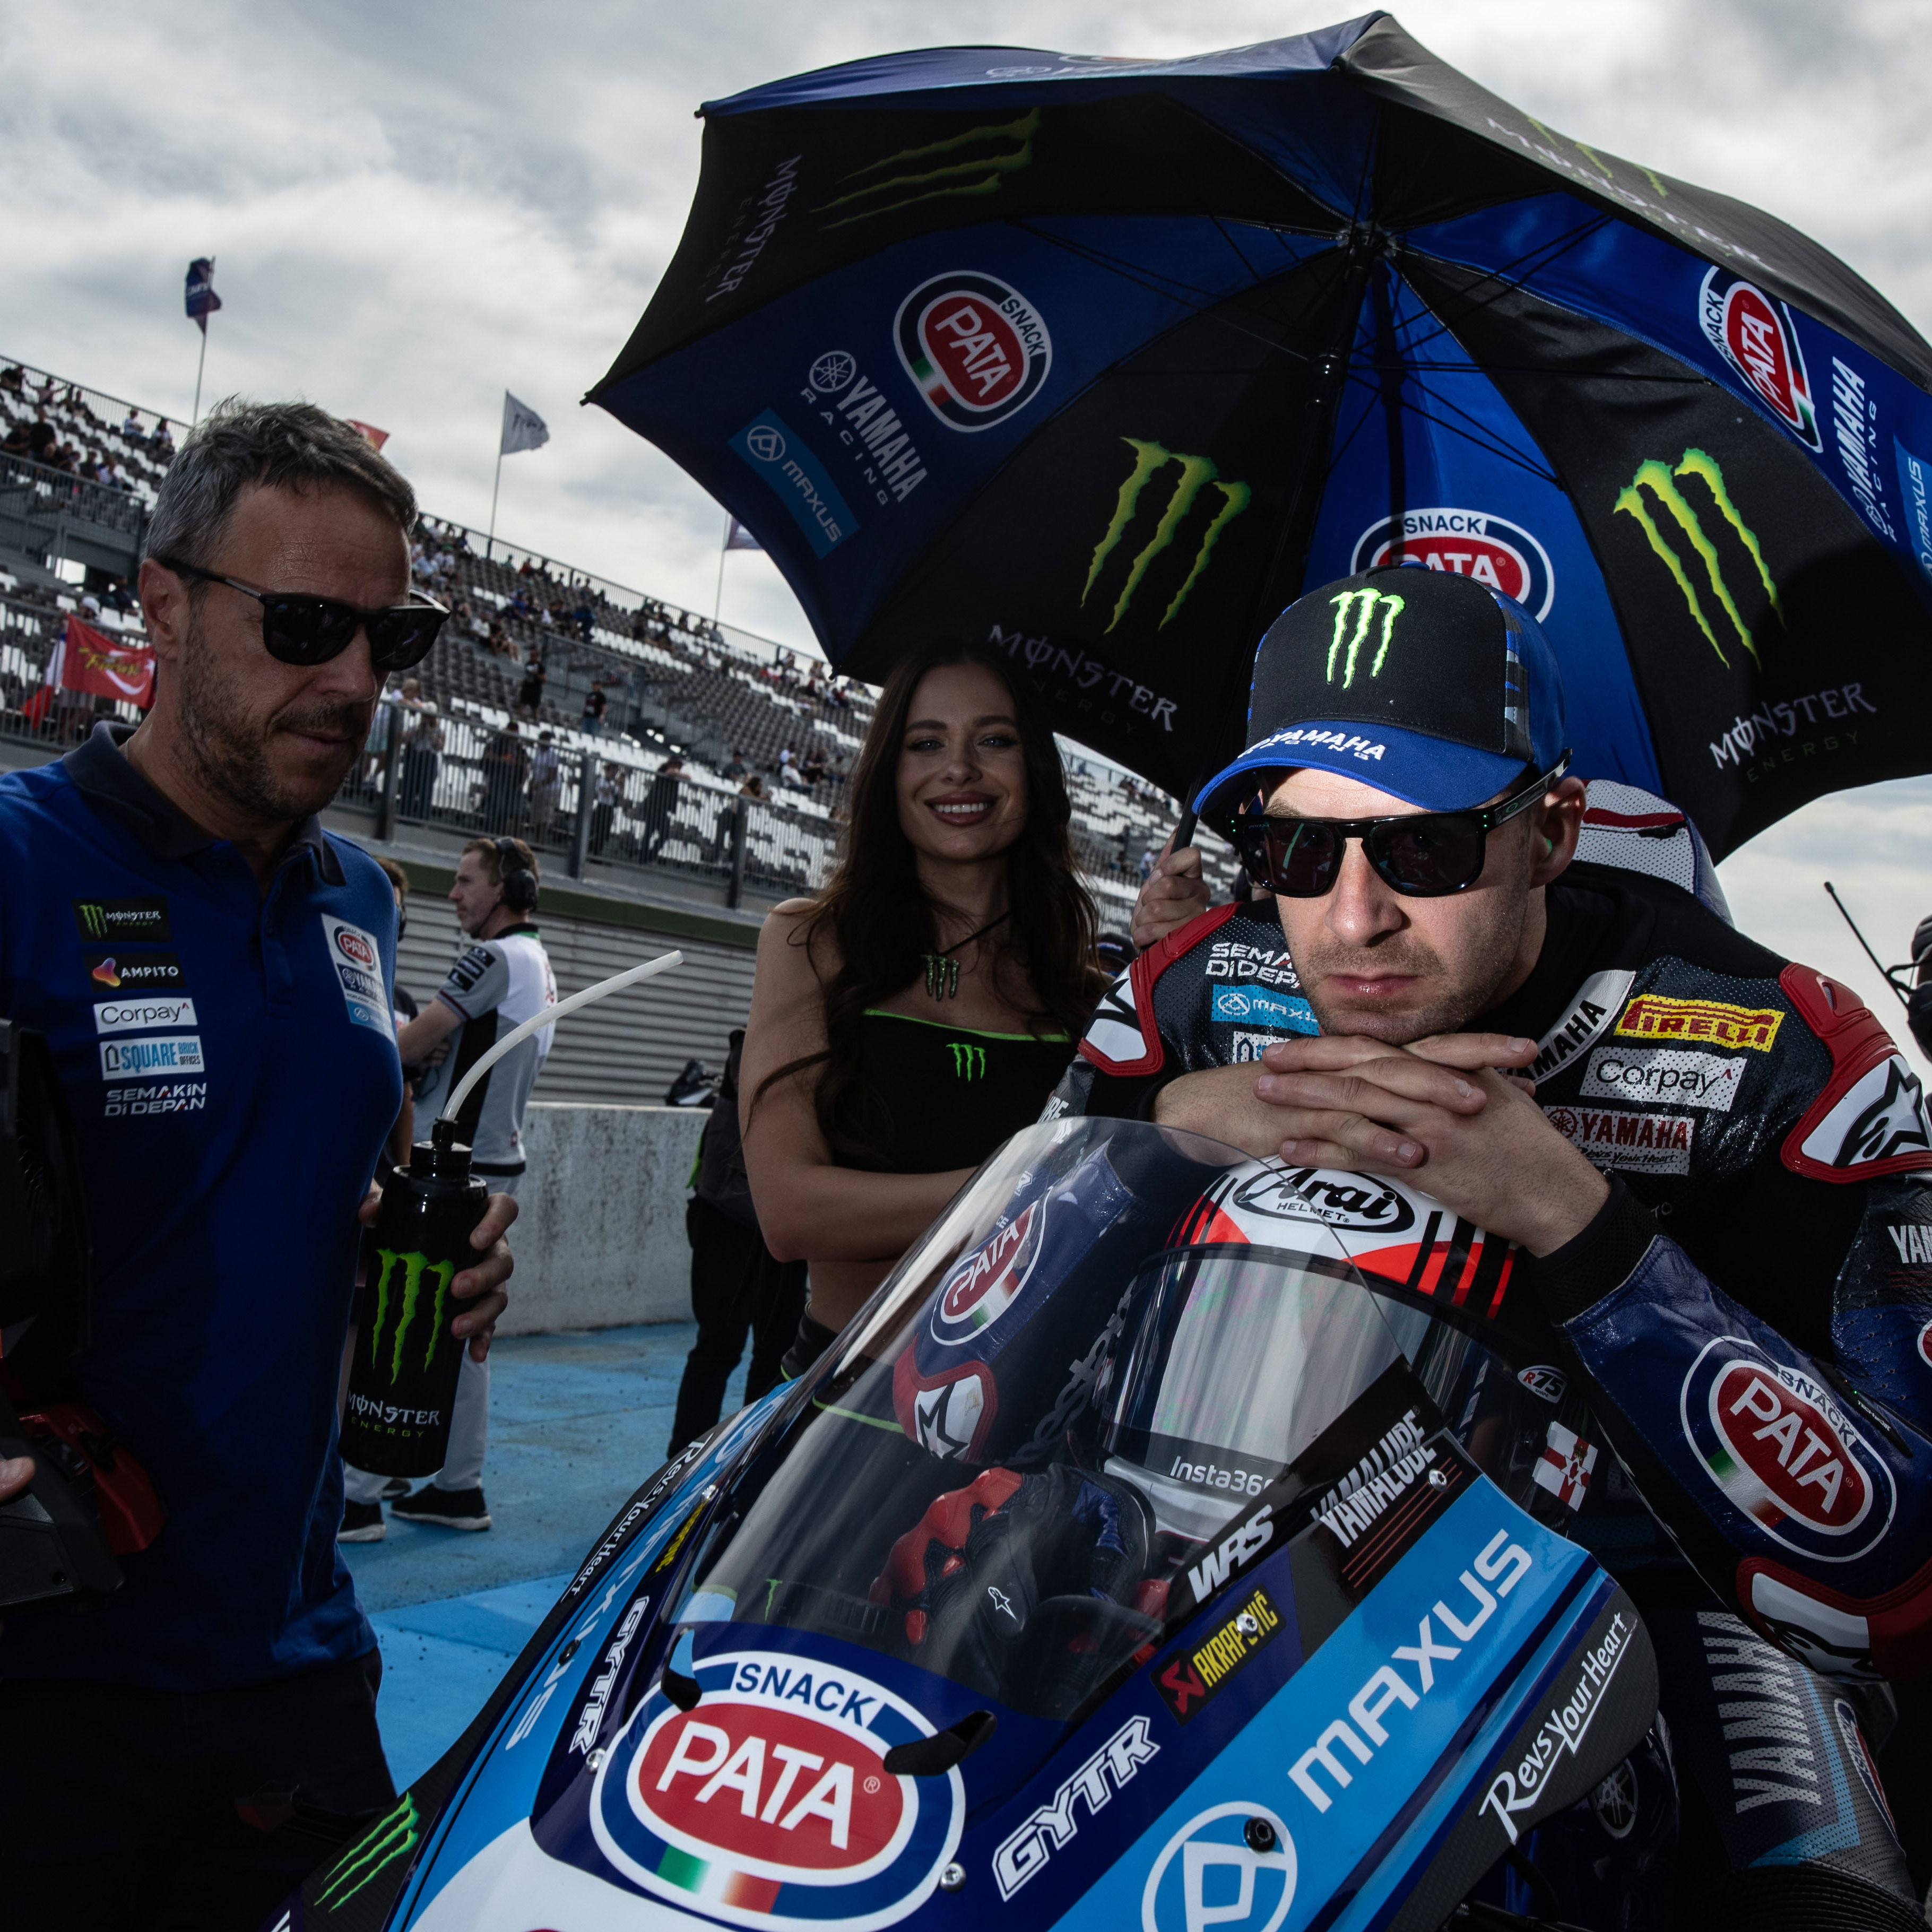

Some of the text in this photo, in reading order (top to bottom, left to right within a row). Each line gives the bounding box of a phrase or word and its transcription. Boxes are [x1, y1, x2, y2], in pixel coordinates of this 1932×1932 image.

[705, 153, 802, 302] MONSTER
[935, 305, 1012, 397] PATA
[1001, 298, 1046, 355] SNACK
[1706, 295, 1737, 363] SNACK
[1741, 311, 1781, 404] PATA
[800, 388, 889, 505] RACING
[836, 375, 929, 503] YAMAHA
[1832, 356, 1876, 501] YAMAHA
[781, 459, 843, 543] MAXUS
[1867, 401, 1898, 543] RACING
[1404, 515, 1483, 534] SNACK
[1908, 456, 1932, 555] MAXUS
[986, 624, 1179, 732] MONSTER
[1271, 729, 1387, 760] YAMAHA
[1708, 681, 1878, 770] MONSTER
[1746, 730, 1858, 783] ENERGY
[106, 910, 161, 922] MONSTER
[343, 937, 369, 958] PATA
[121, 965, 179, 979] AMPITO
[1209, 942, 1294, 969] SEMA
[101, 1006, 181, 1025] Corpay
[178, 1042, 200, 1054] BRICK
[1621, 999, 1773, 1045] PIRELLI
[120, 1042, 178, 1073] SQUARE
[179, 1055, 201, 1065] OFFICES
[1596, 1059, 1719, 1099] Corpay
[107, 1082, 207, 1103] SEMAKIN
[130, 1096, 206, 1115] DEPAN
[1581, 1112, 1688, 1151] YAMAHA
[1238, 1167, 1397, 1219] Arai
[1276, 1202, 1346, 1221] HELMET
[952, 1220, 1019, 1308] PATA
[346, 1389, 440, 1427] MONSTER
[350, 1416, 425, 1439] ENERGY
[1779, 1368, 1855, 1446] SNACK
[1730, 1377, 1844, 1513] PATA
[1187, 1504, 1275, 1604] WRS
[568, 1595, 651, 1755] GYTR
[735, 1663, 878, 1729] SNACK
[1287, 1528, 1532, 1814] MAXUS
[1696, 1611, 1822, 1815] YAMAHA
[655, 1720, 855, 1851] PATA
[991, 1715, 1161, 1903] GYTR
